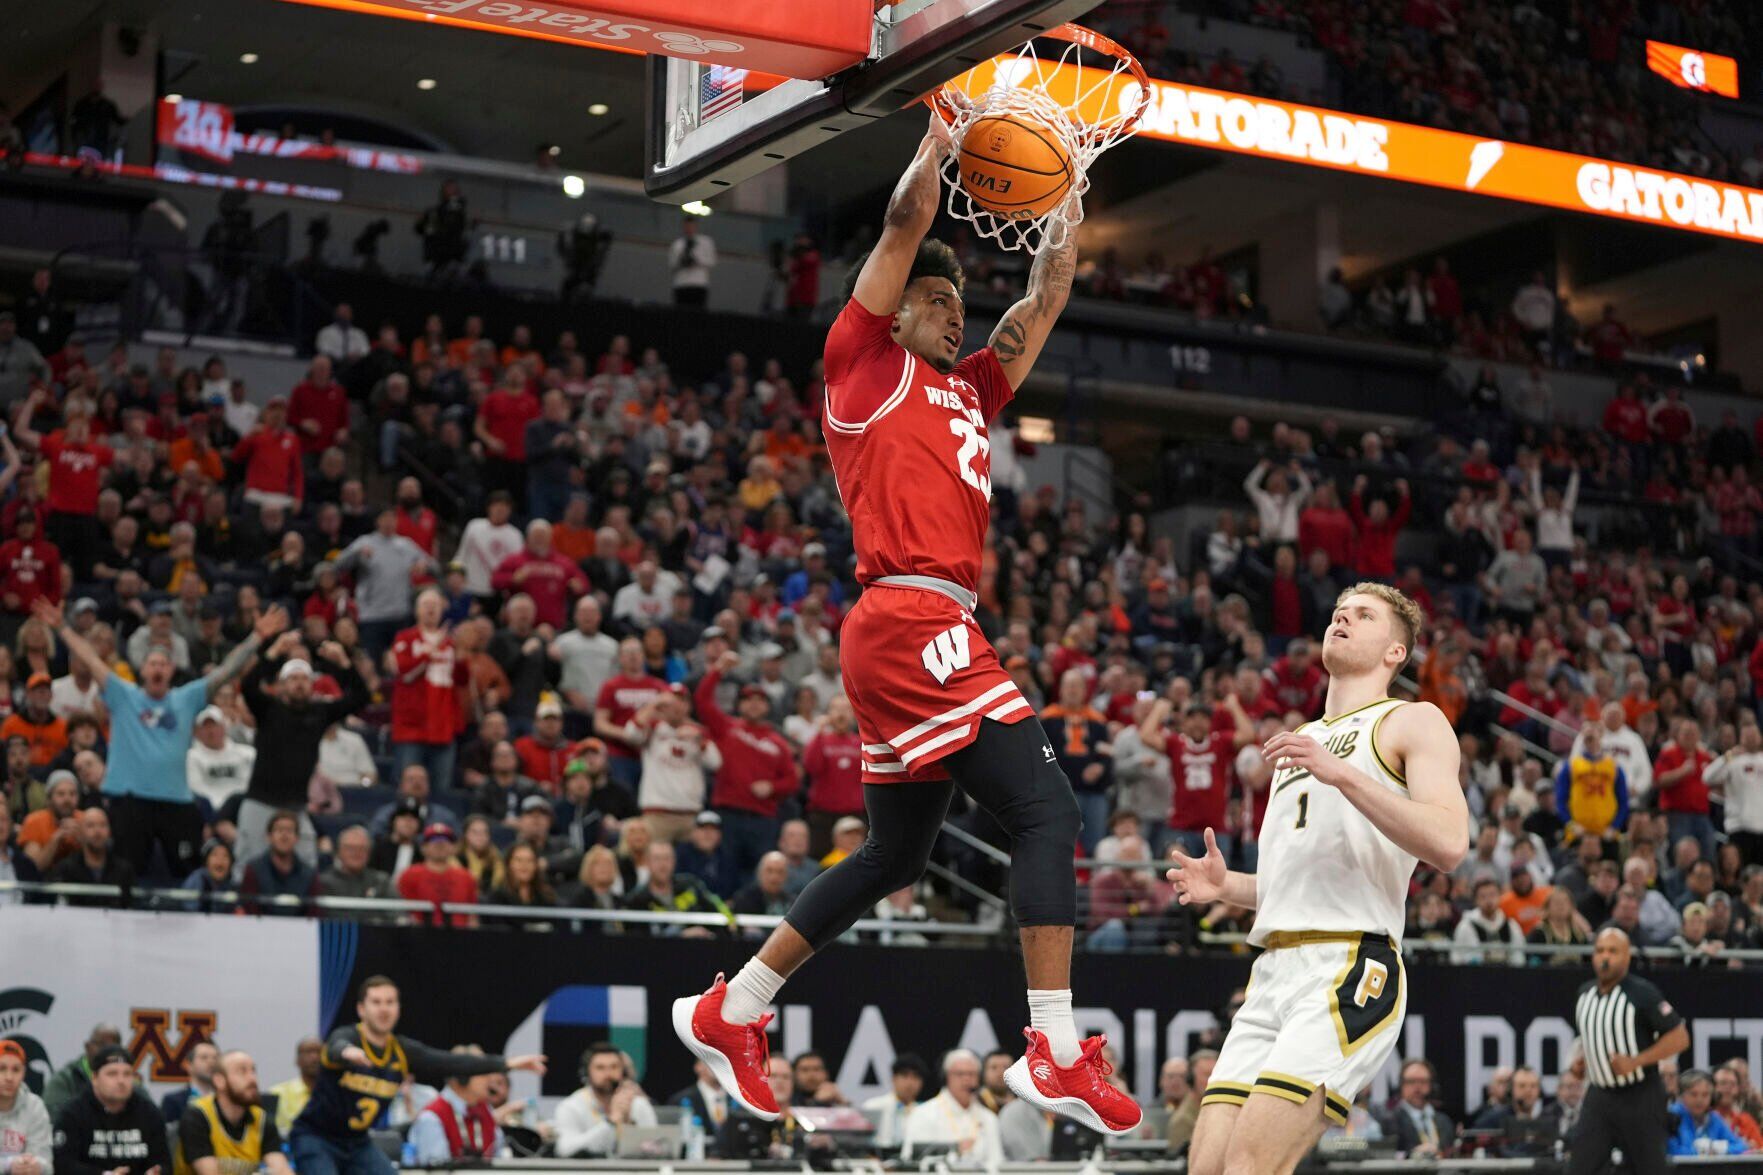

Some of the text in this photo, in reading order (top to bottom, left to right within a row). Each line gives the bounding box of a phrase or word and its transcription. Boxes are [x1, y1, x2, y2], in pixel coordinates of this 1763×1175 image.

[1118, 81, 1389, 171] GATORADE
[482, 233, 527, 264] 111
[1169, 345, 1211, 374] 112
[921, 623, 971, 687] W
[1294, 792, 1309, 830] 1
[1353, 957, 1388, 1009] P
[348, 1097, 380, 1130] 3
